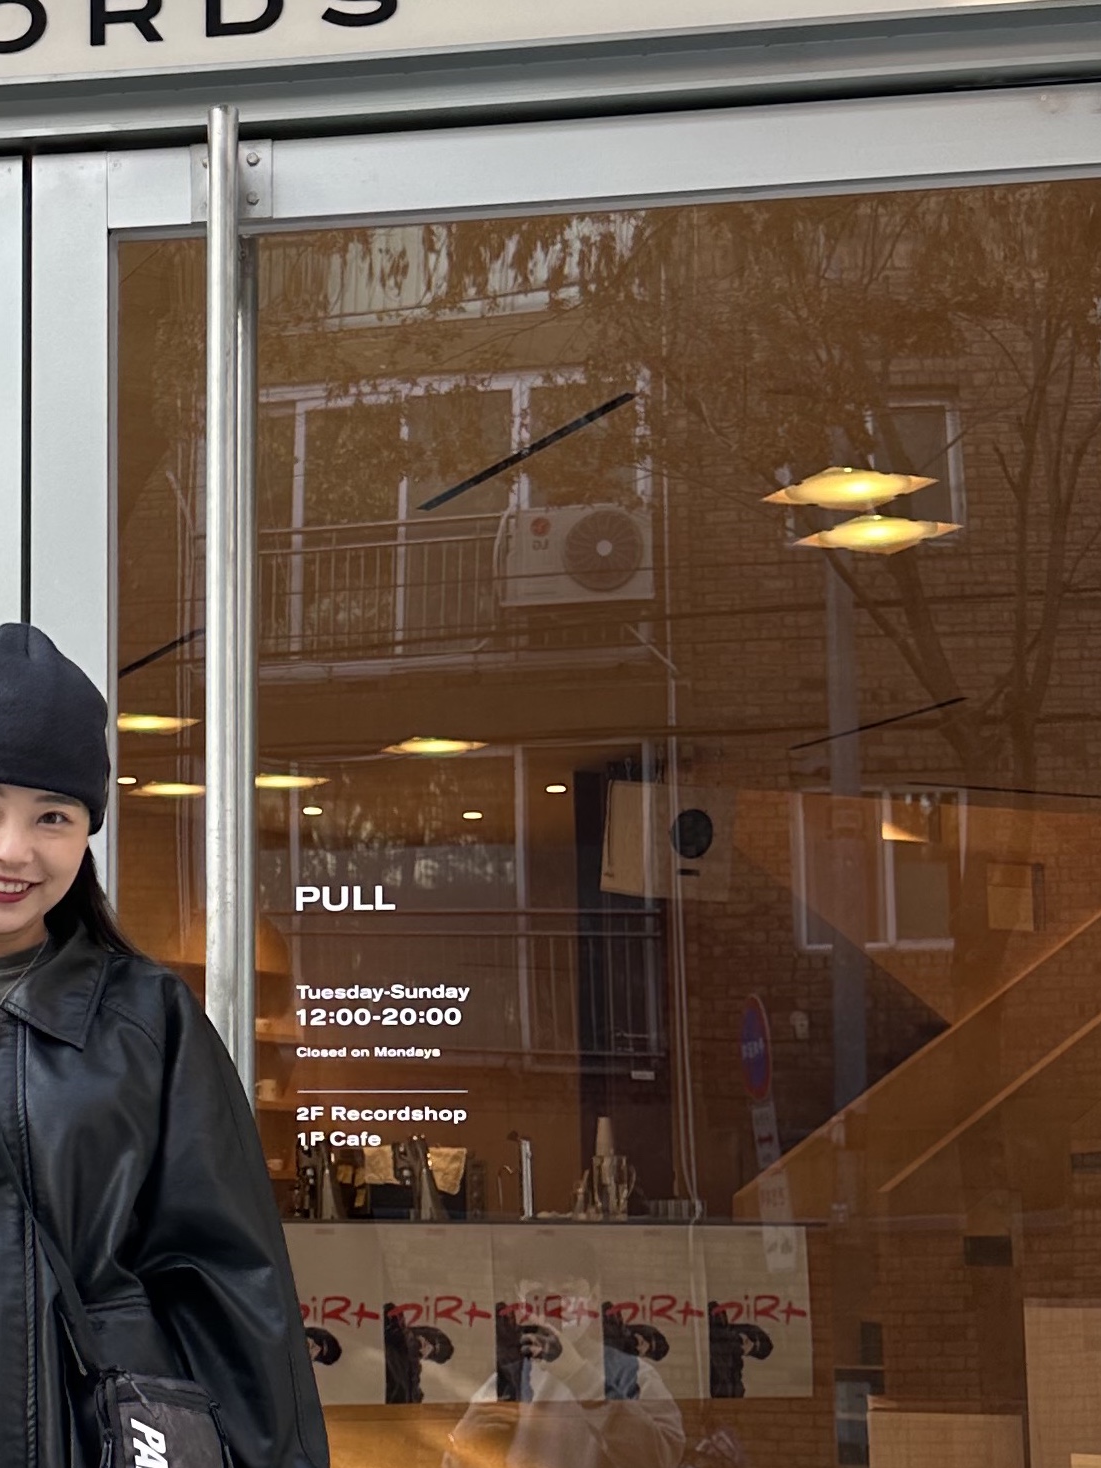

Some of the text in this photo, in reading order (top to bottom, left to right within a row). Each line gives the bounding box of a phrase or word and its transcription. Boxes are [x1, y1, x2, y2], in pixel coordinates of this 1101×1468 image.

[295, 885, 397, 913] PULL
[295, 984, 471, 1003] Tuesday-Sunday
[295, 1008, 462, 1027] 12:00-20:00
[295, 1046, 441, 1060] Closed on Mondays
[296, 1105, 467, 1125] 2F Recordshop
[329, 1131, 382, 1148] Cafe
